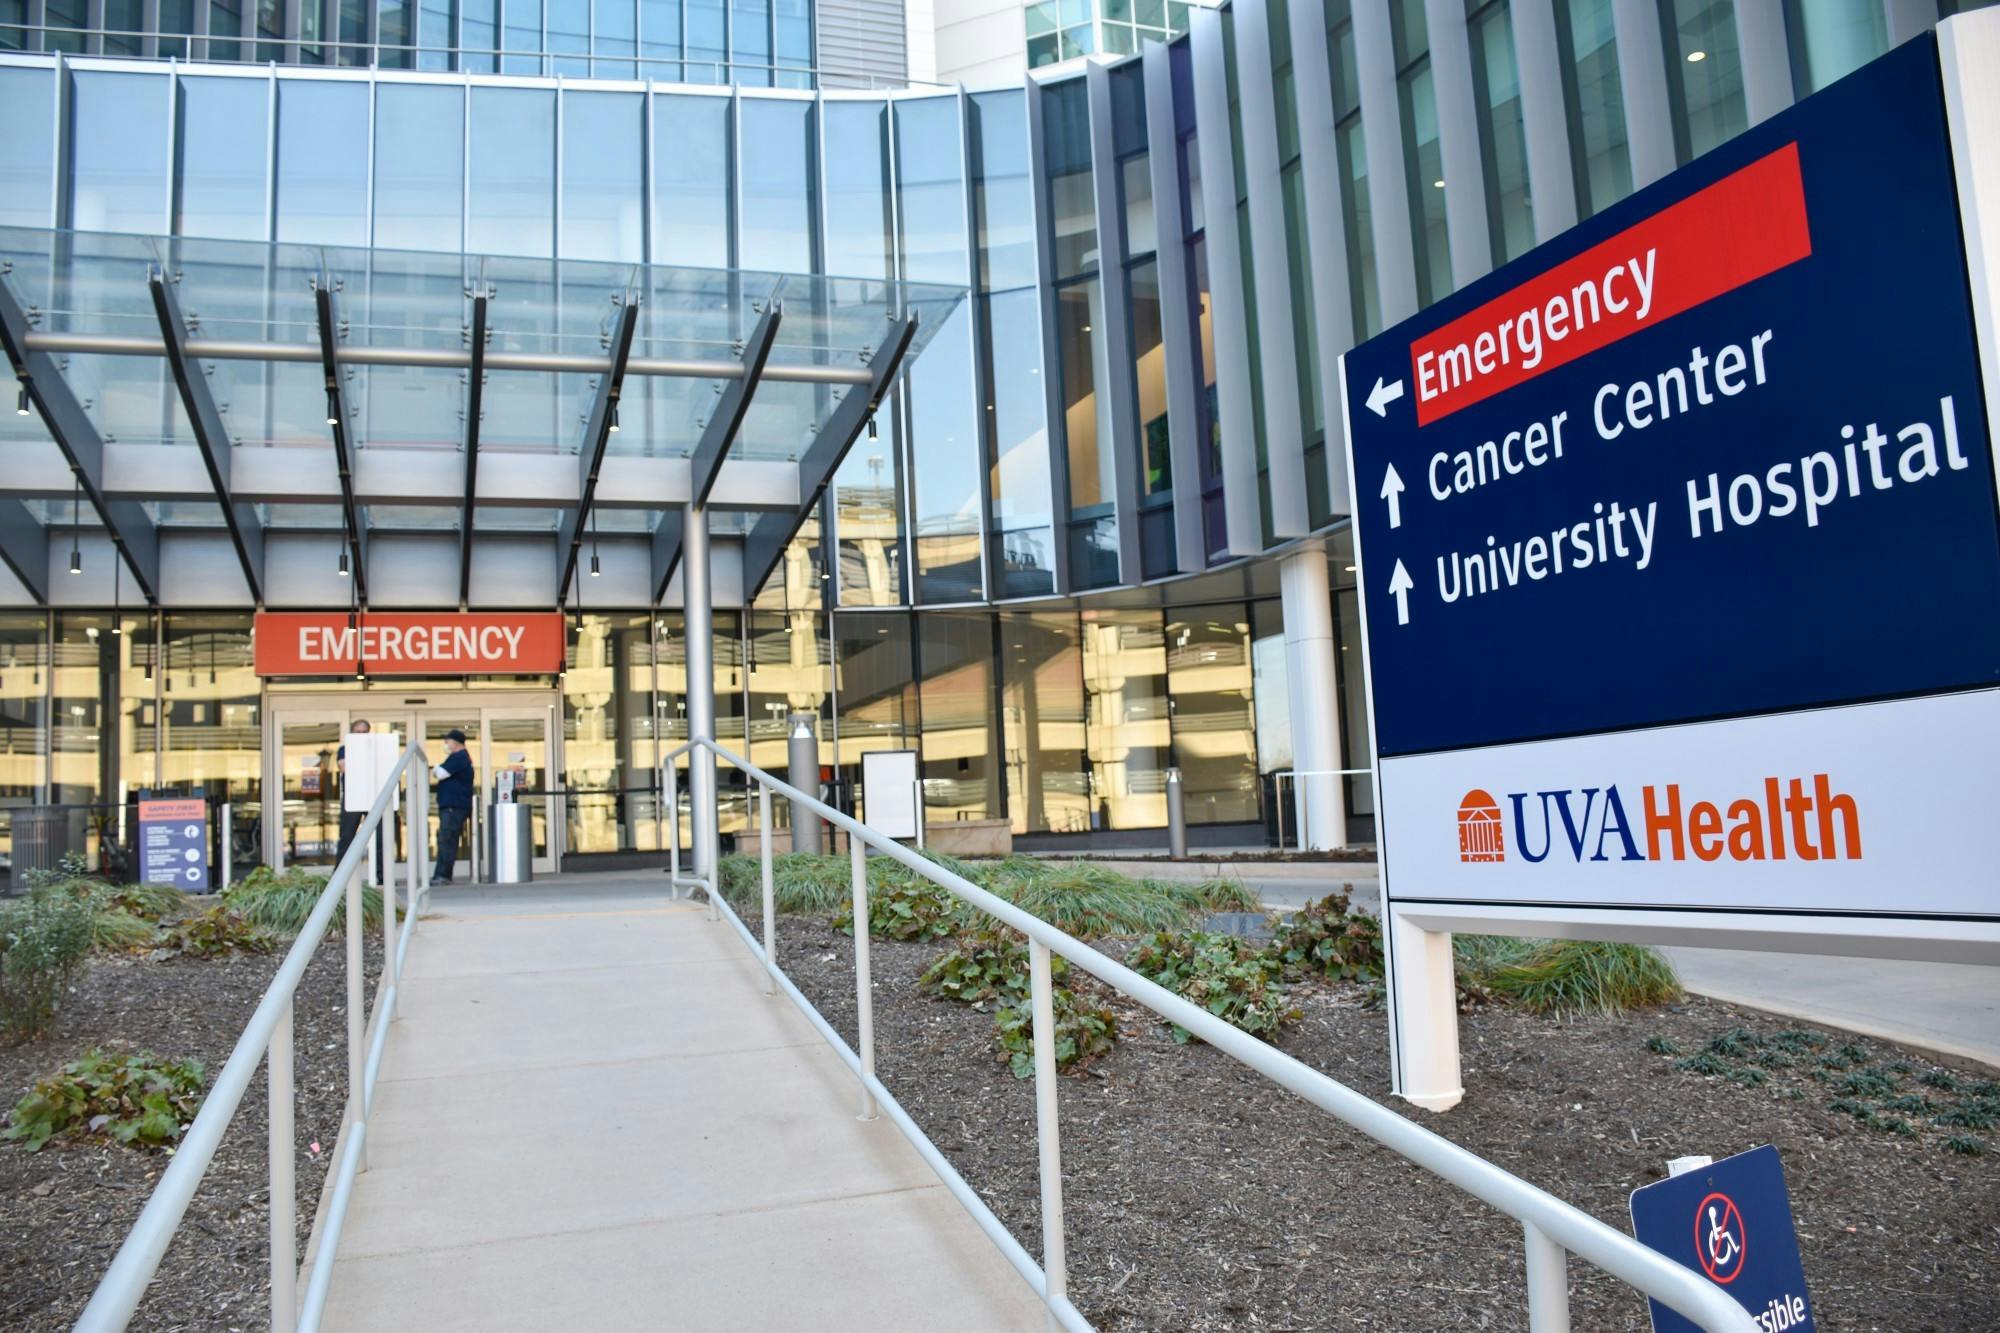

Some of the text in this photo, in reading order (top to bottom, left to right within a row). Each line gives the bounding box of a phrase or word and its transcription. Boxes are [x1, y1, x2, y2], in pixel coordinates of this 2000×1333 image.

[1416, 248, 1656, 403] Emergency
[1428, 329, 1773, 501] Cancer Center
[1437, 395, 1969, 603] University Hospital
[299, 625, 525, 661] EMERGENCY
[1752, 1294, 1806, 1333] sible
